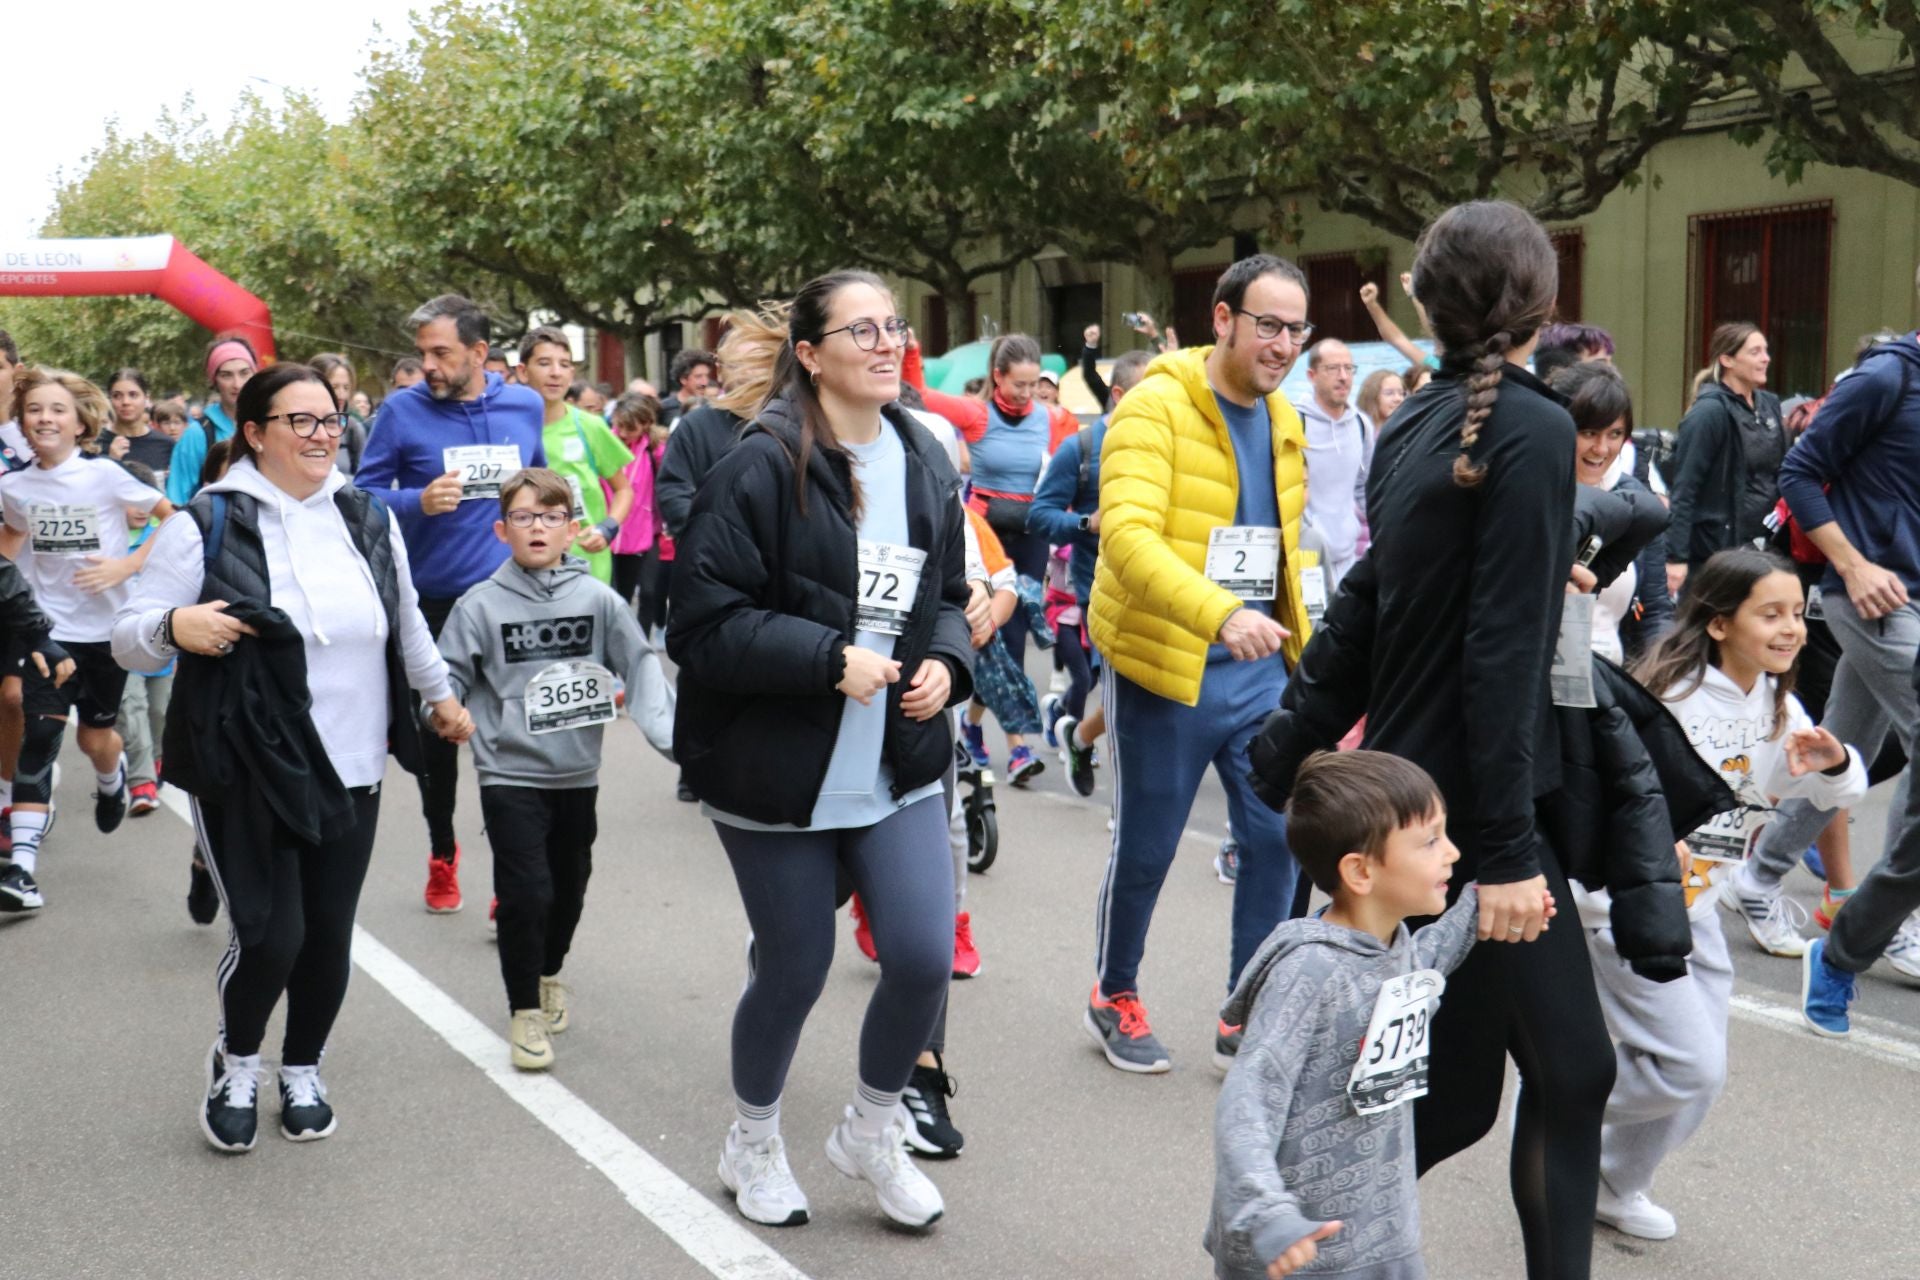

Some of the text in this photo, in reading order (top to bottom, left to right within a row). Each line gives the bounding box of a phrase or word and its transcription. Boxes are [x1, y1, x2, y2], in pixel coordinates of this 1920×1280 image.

[6, 252, 30, 266] DE
[0, 274, 58, 285] EPORTES
[466, 463, 502, 481] 207
[38, 520, 87, 537] 2725
[1233, 549, 1247, 573] 2
[858, 569, 899, 602] 72
[505, 619, 590, 651] +8000
[539, 678, 599, 708] 3658
[1711, 805, 1748, 830] 738
[1368, 1007, 1427, 1065] 3739
